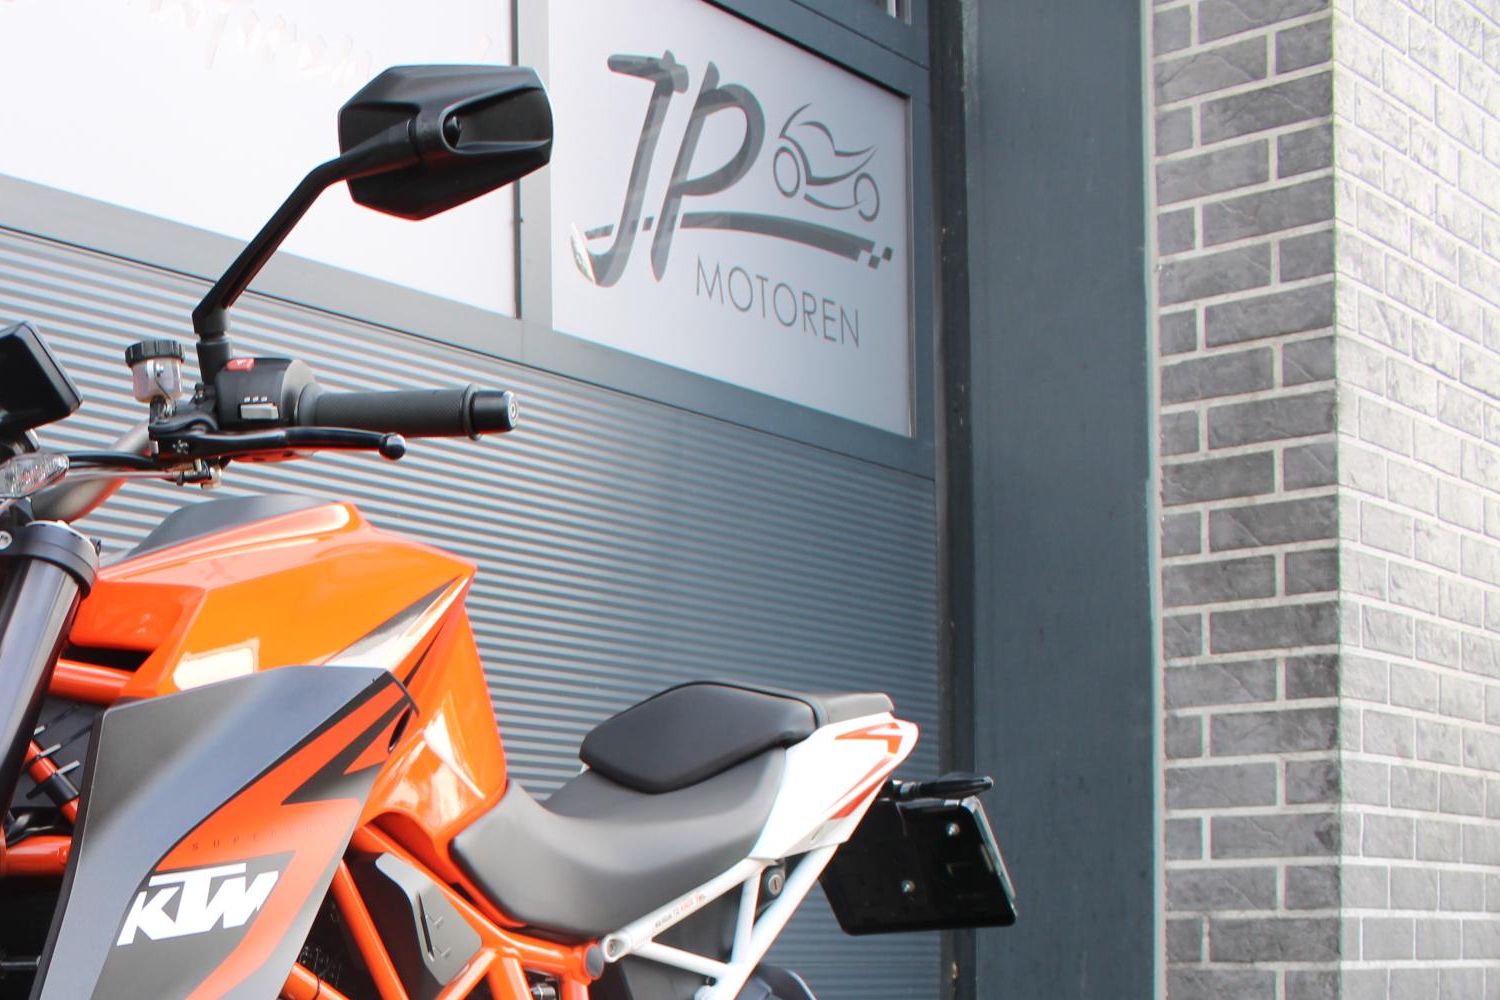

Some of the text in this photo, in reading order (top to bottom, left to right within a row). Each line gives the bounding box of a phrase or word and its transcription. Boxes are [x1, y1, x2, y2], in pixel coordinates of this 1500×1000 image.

[570, 49, 766, 288] JP
[696, 254, 860, 348] MOTOREN
[116, 862, 279, 946] KTM
